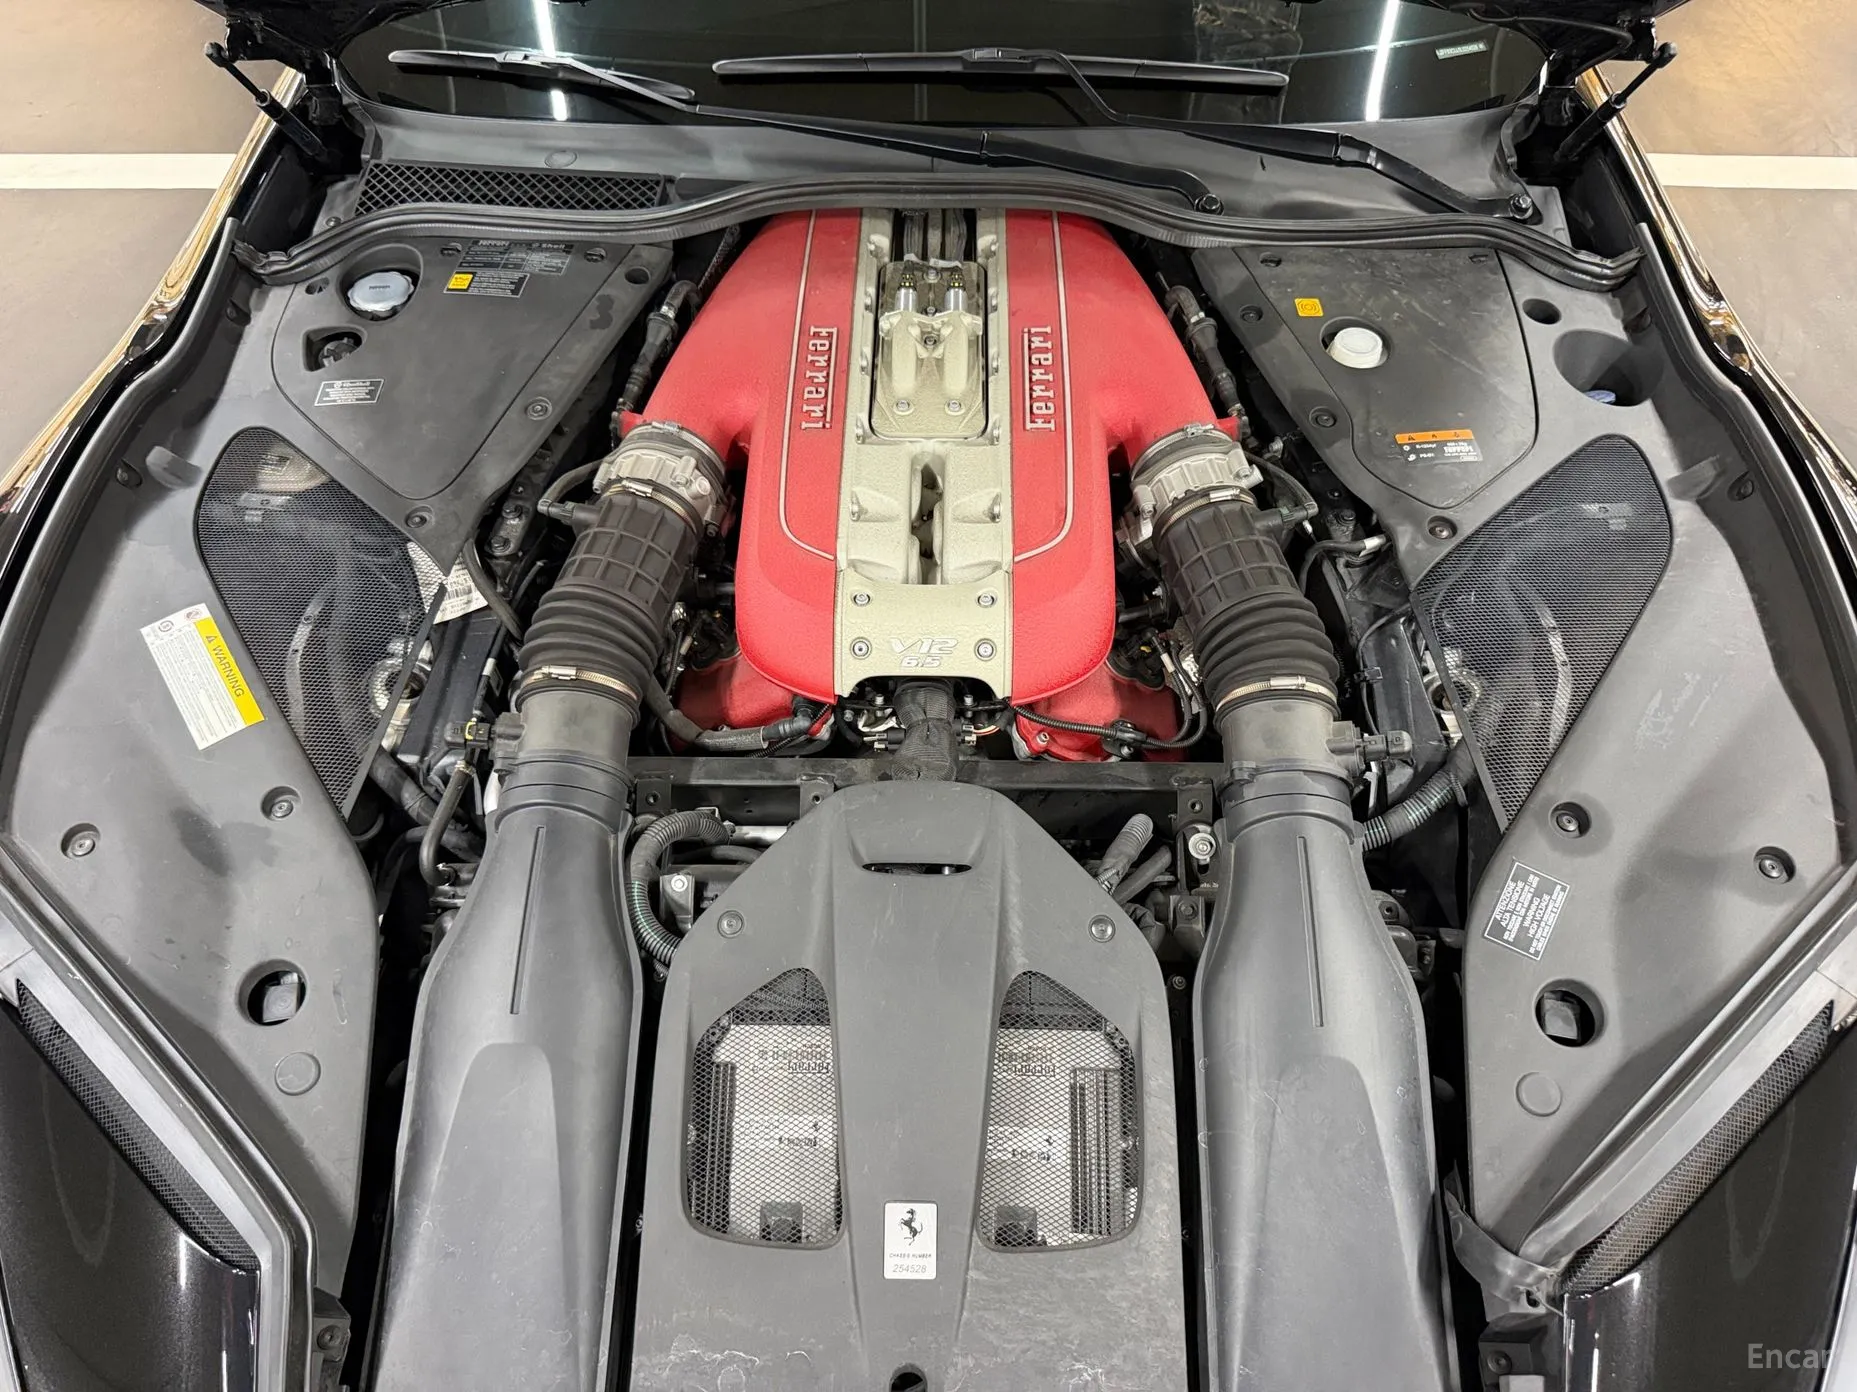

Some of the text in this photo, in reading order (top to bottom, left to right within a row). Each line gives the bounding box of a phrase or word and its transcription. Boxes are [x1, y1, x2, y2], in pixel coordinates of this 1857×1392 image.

[801, 325, 838, 430] Ferrari
[1023, 325, 1056, 432] Ferrari
[890, 636, 958, 655] V12
[900, 655, 942, 668] 6.5
[213, 644, 245, 698] WARNING
[1495, 881, 1516, 920] ATTENZIONE
[1499, 910, 1511, 927] ALTA
[1506, 879, 1525, 911] TENSIONE
[1522, 896, 1540, 927] WARNING
[1527, 920, 1539, 937] HIGH
[1533, 893, 1550, 921] VOLTAGE
[892, 1263, 928, 1274] 254528
